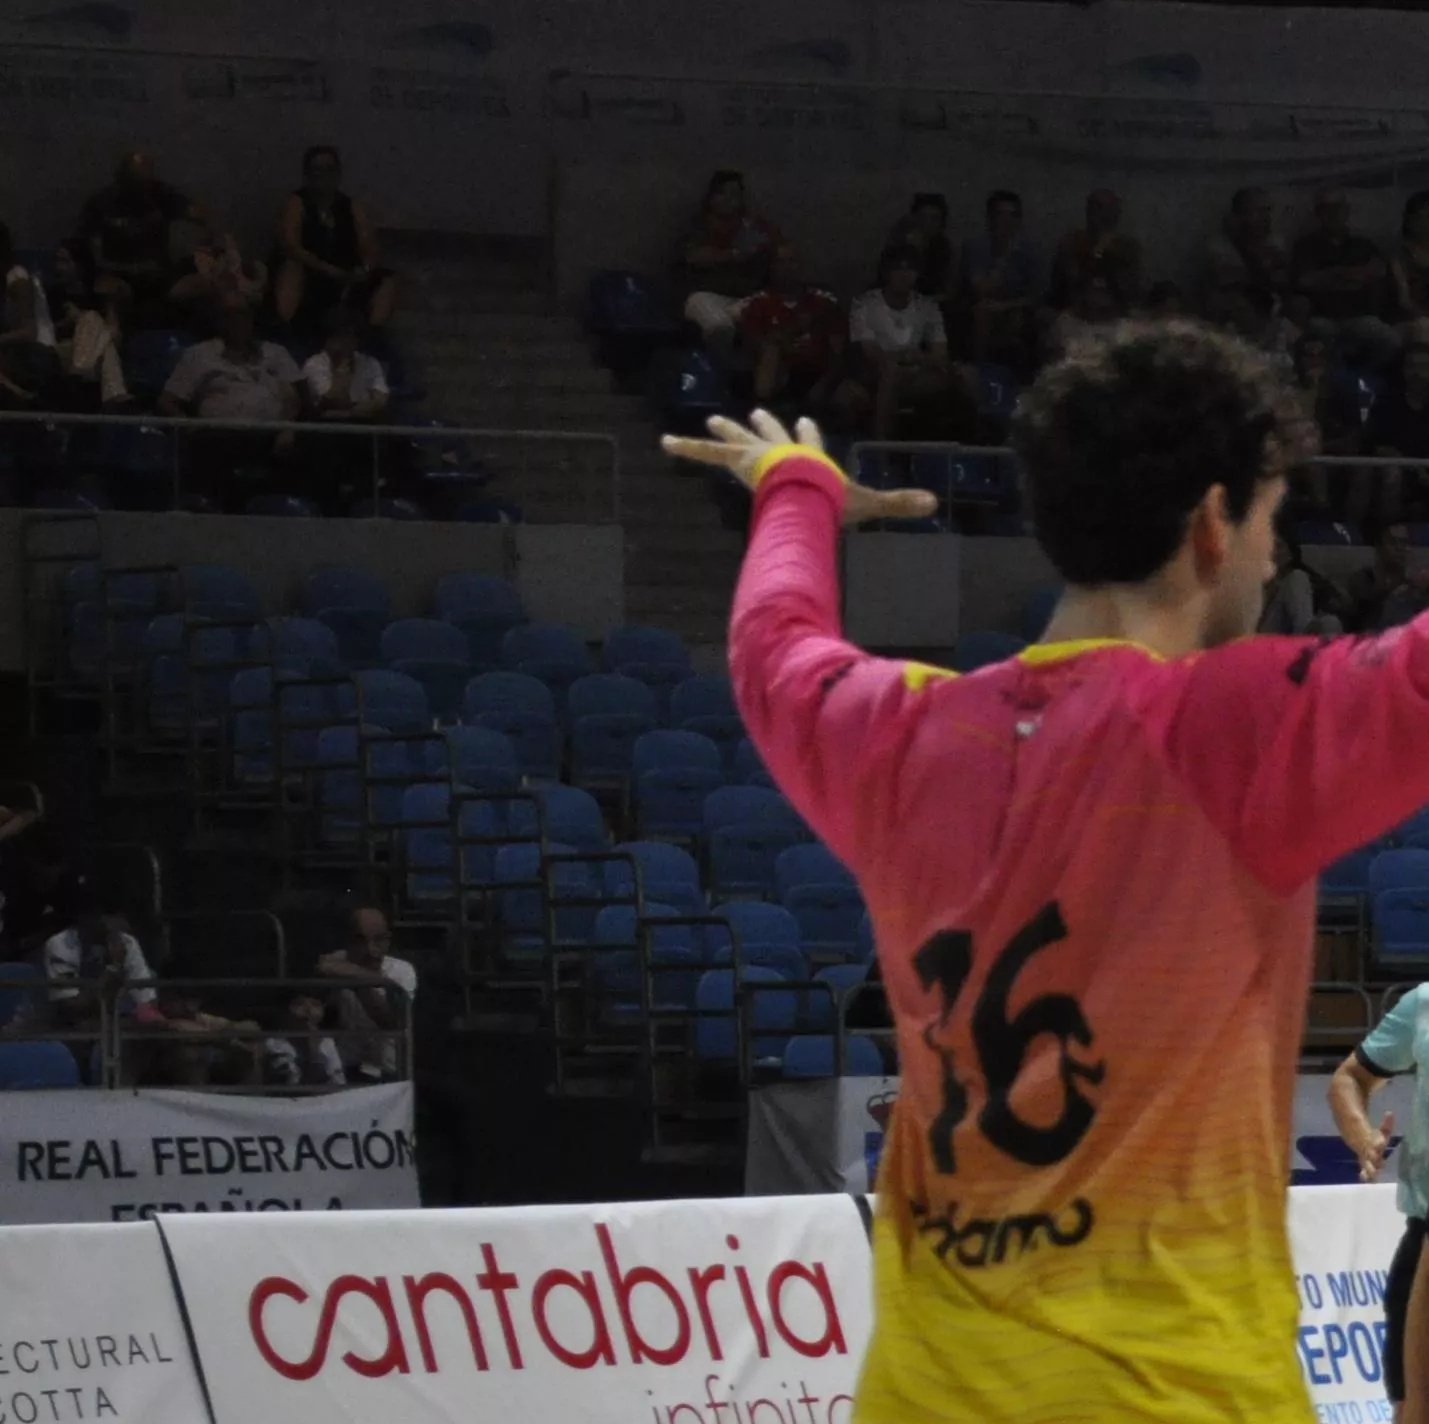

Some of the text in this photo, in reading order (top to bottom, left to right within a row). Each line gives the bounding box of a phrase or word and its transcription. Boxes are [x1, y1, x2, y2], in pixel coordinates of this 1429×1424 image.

[911, 899, 1105, 1176] 16
[17, 1139, 137, 1182] REAL
[246, 1222, 849, 1381] cantabria
[0, 1386, 118, 1424] OTTA
